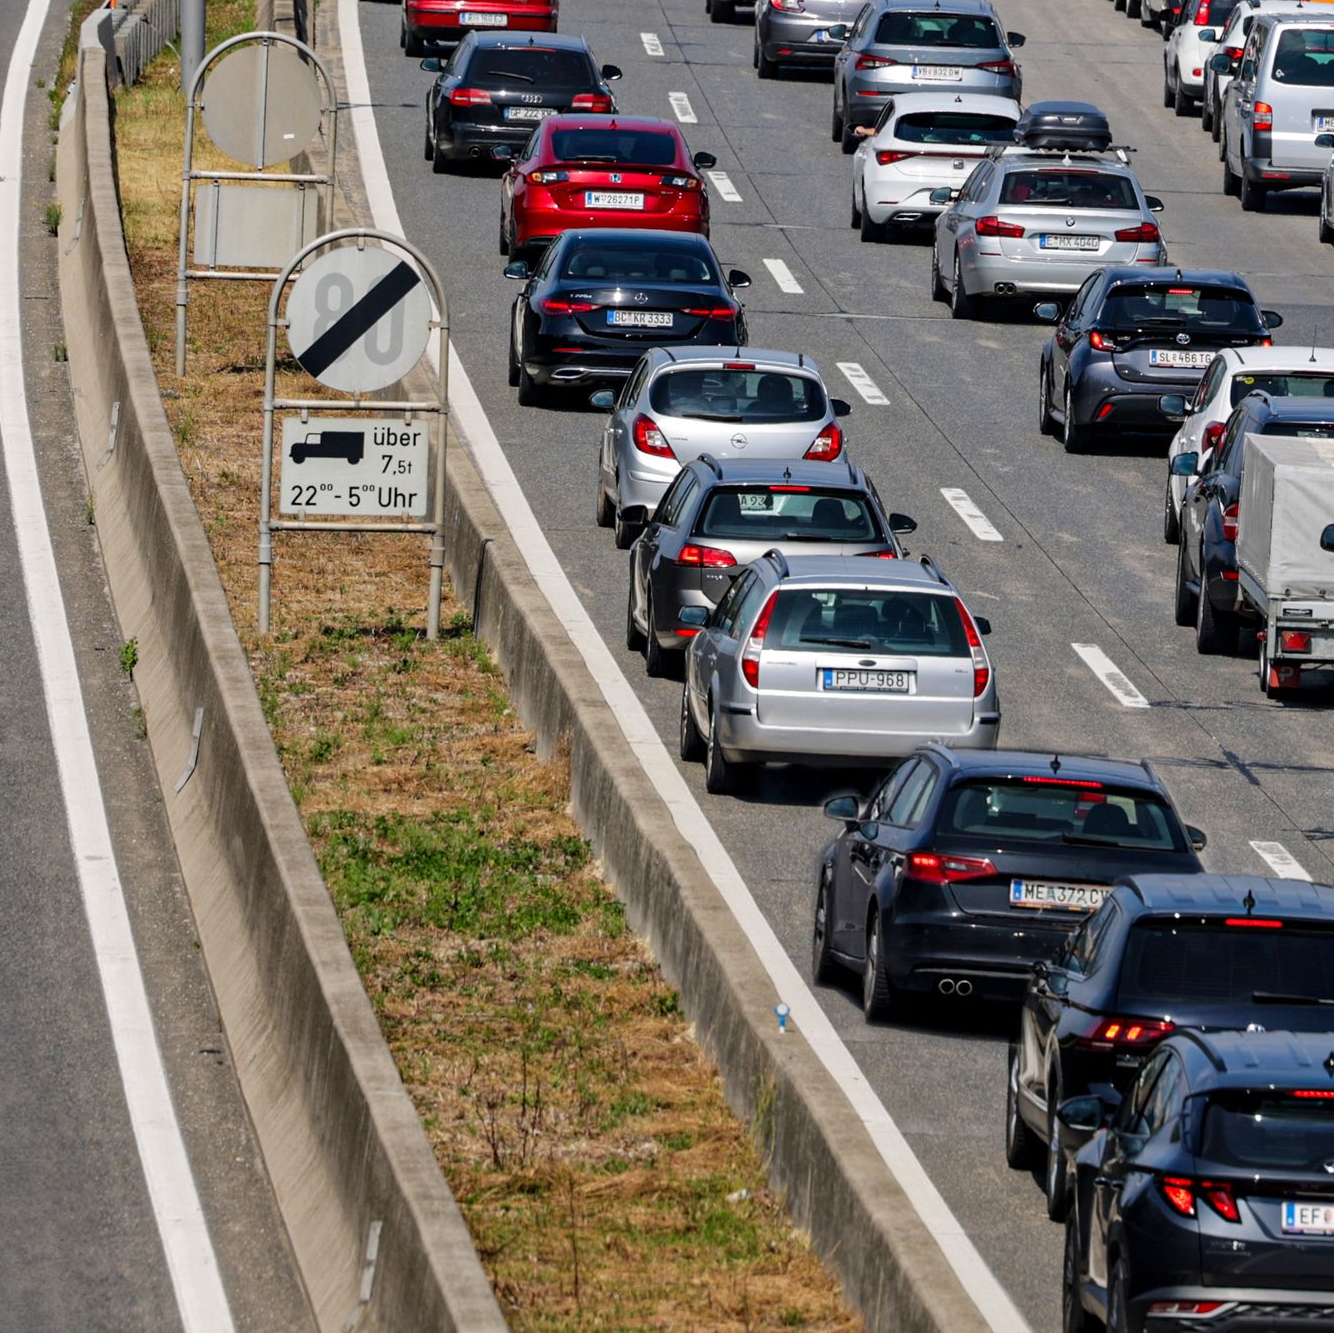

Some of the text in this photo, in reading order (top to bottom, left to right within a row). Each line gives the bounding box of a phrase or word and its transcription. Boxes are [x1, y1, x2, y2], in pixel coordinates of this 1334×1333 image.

[312, 272, 405, 365] 80
[1159, 352, 1171, 362] SL
[373, 427, 422, 446] über
[381, 454, 413, 476] 7,5t
[377, 486, 417, 508] Uhr
[836, 671, 905, 688] PPU-968
[1024, 882, 1043, 899] ME
[1299, 1207, 1320, 1225] EF
